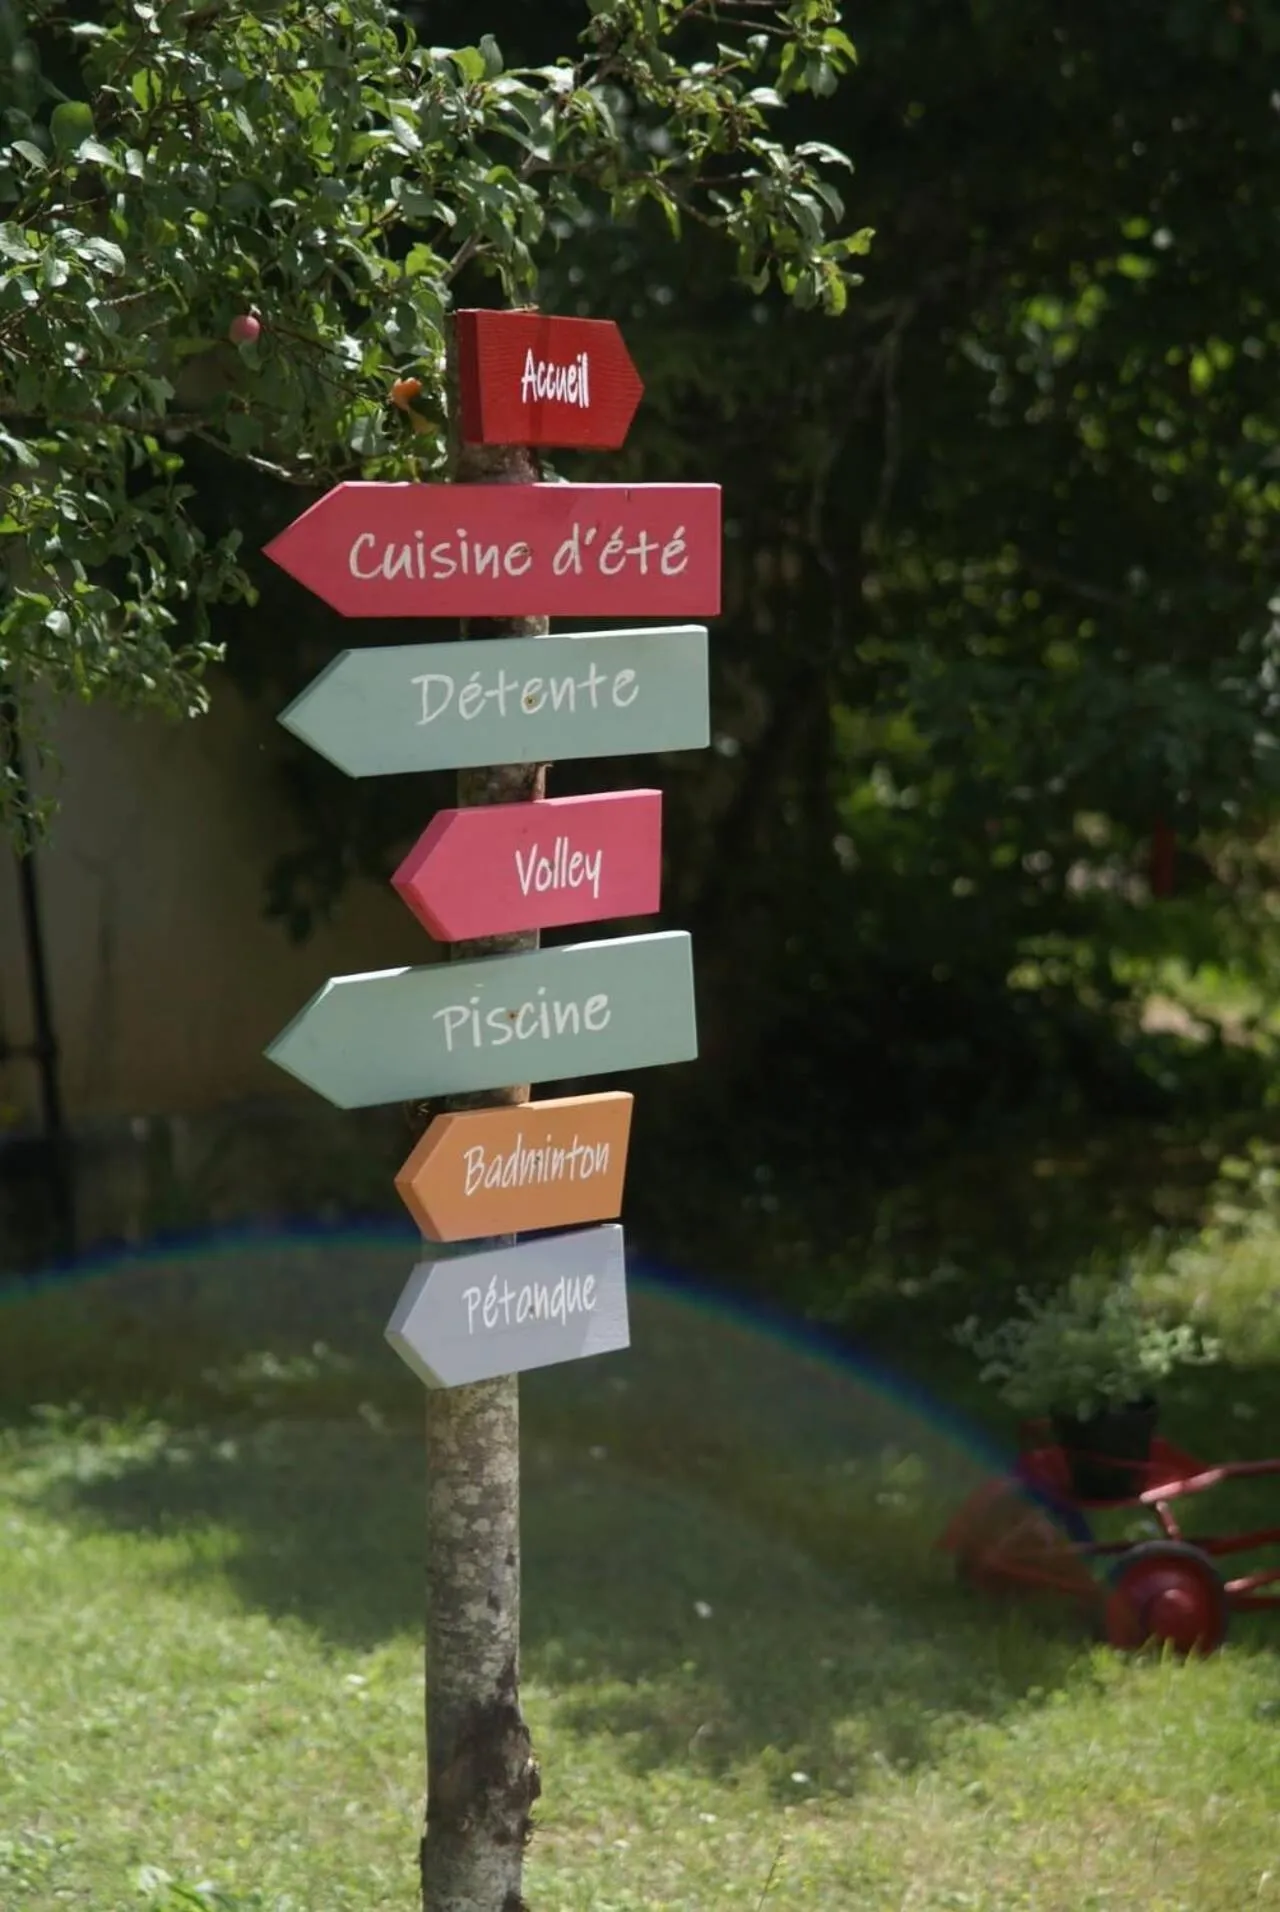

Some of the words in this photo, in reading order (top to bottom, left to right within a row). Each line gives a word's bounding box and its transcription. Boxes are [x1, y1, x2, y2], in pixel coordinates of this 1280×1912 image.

[521, 348, 589, 408] Accueil
[349, 529, 532, 580] Cuisine
[552, 523, 689, 576] d'été
[411, 662, 640, 726] Détente
[515, 836, 602, 899] Volley
[432, 986, 611, 1052] Piscine
[463, 1132, 610, 1197] Badminton
[462, 1273, 597, 1335] Pétanque
